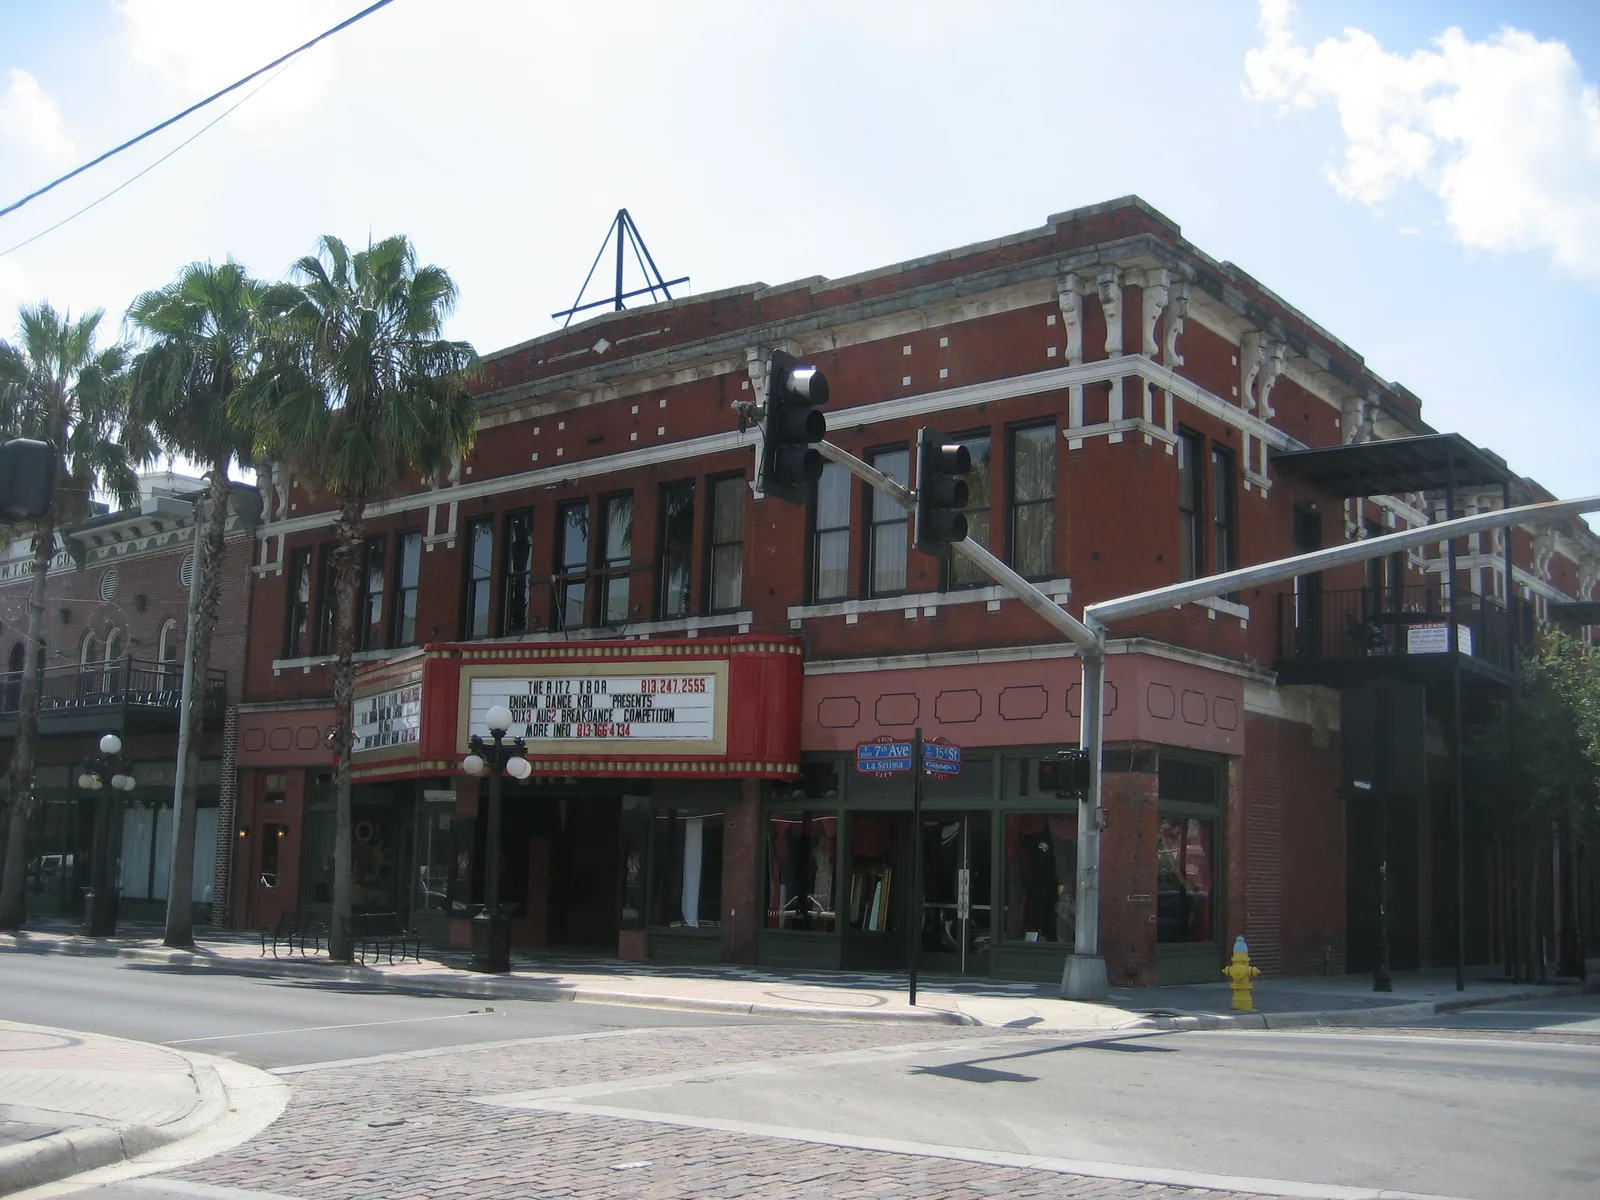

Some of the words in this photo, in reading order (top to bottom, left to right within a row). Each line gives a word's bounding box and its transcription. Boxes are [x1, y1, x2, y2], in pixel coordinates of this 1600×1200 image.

[528, 680, 543, 694] THE
[546, 680, 570, 694] RITZ
[579, 680, 607, 694] YBOR
[641, 678, 705, 693] 813.247.2555
[509, 694, 538, 708] ENIGMA
[545, 694, 572, 708] DANCE
[577, 694, 593, 708] KRU
[561, 708, 614, 723] BREAKDANCE
[525, 723, 549, 737] MORE
[553, 723, 571, 737] INFO
[888, 744, 909, 757] Ave
[948, 748, 957, 761] St
[866, 761, 876, 770] La
